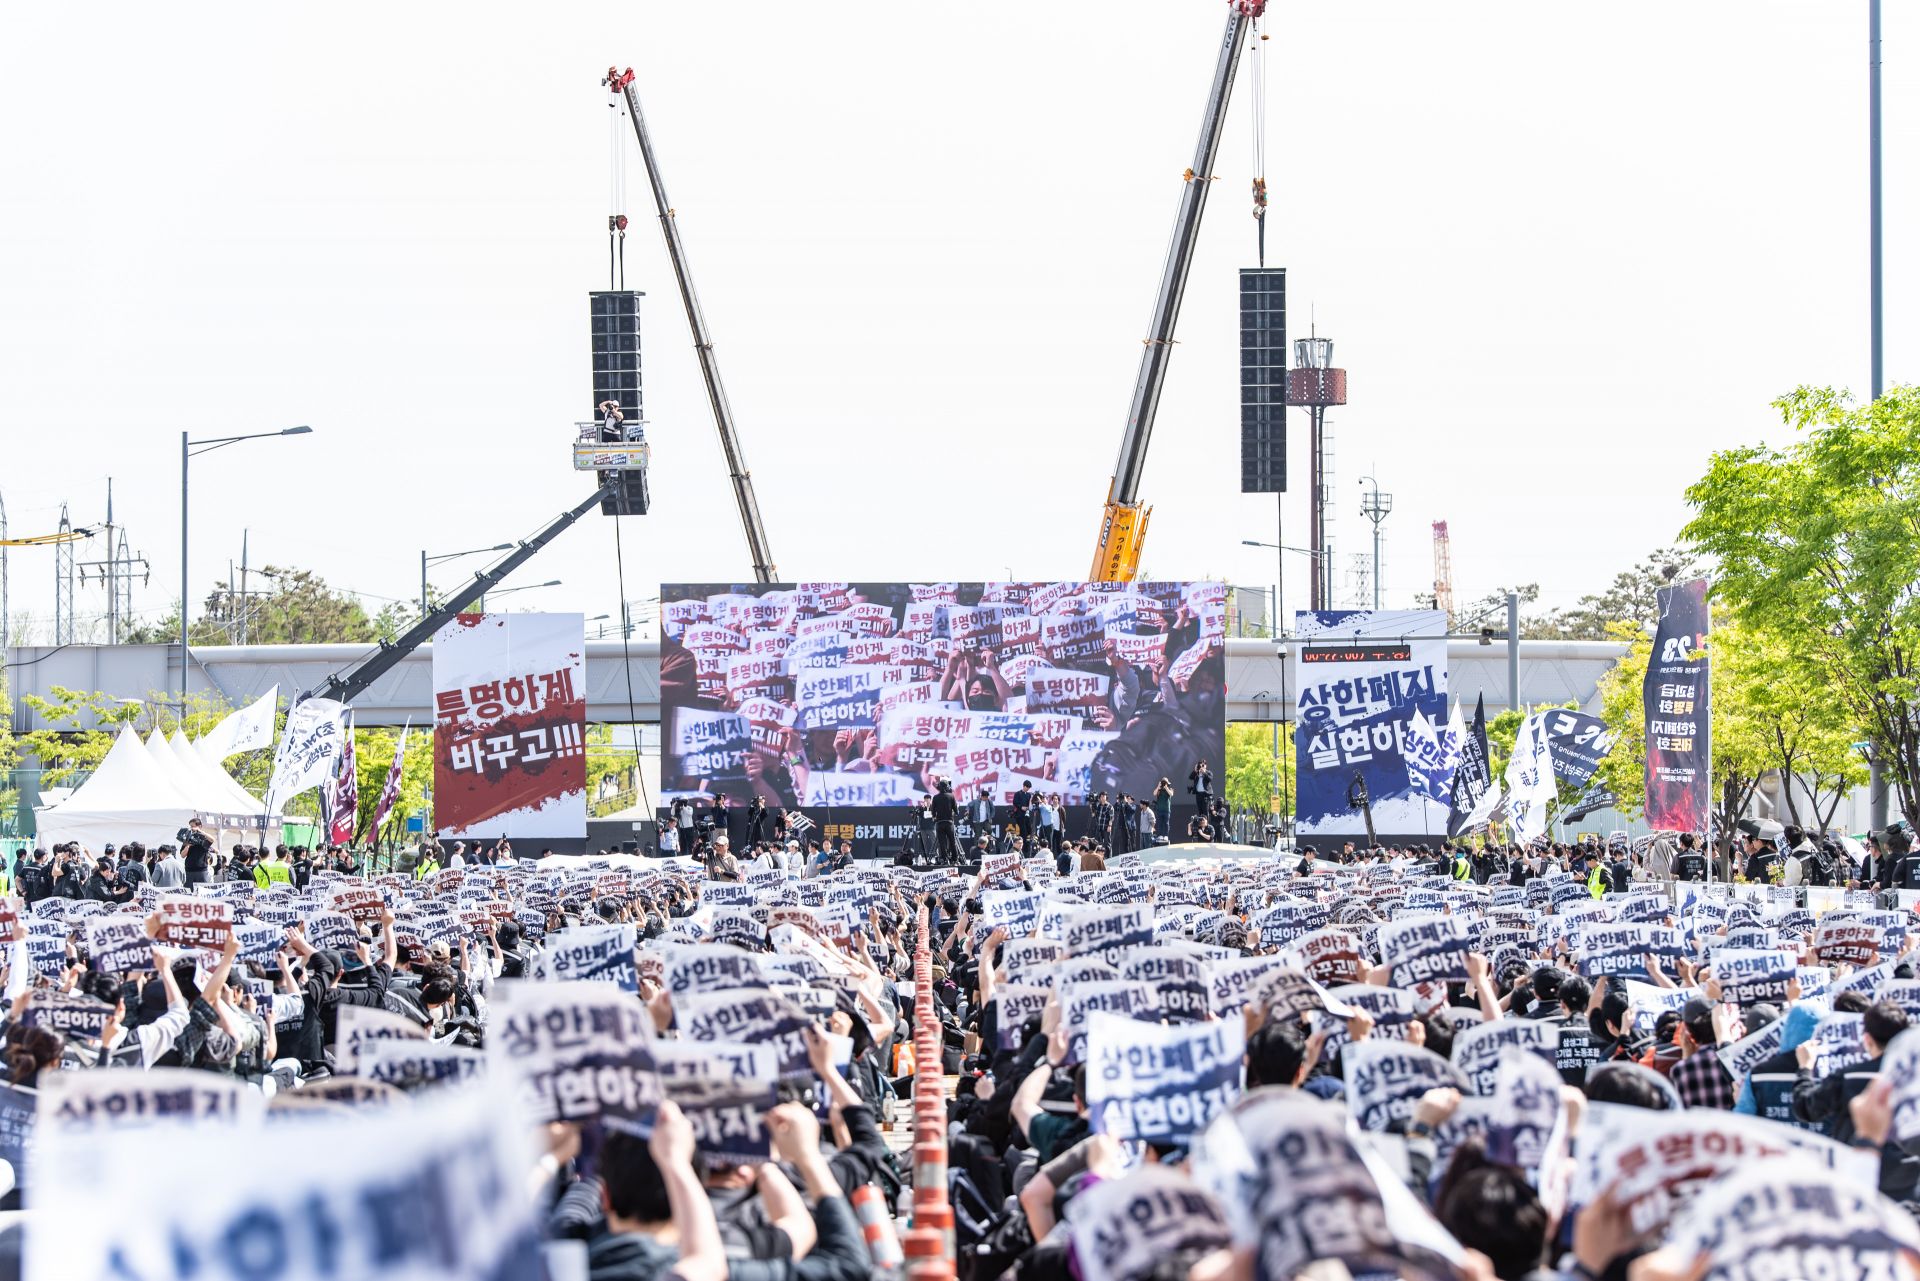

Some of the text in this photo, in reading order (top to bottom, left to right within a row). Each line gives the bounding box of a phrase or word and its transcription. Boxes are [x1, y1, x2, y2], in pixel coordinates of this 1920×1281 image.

[1225, 17, 1236, 48] KATO
[1101, 517, 1111, 548] KATO
[1004, 619, 1031, 638] 하게
[1046, 618, 1098, 640] 투명하게
[1205, 616, 1225, 629] 투명
[1053, 640, 1105, 660] 바꾸고!!!
[1119, 636, 1159, 649] 명하게
[730, 658, 782, 680] 투명하게
[802, 672, 871, 699] 상한폐지
[1032, 677, 1099, 696] 투명하게
[1298, 665, 1436, 722] 상한폐지
[436, 667, 575, 726] 투명하게
[883, 684, 932, 711] 명하게
[804, 700, 875, 728] 실현하자
[683, 717, 744, 744] 상한폐지
[900, 715, 971, 737] 투명하게
[451, 722, 583, 773] 바꾸고!!!
[955, 748, 1032, 775] 투명하게
[824, 824, 884, 839] 투명하게
[984, 855, 1017, 870] 투명하게
[466, 878, 492, 887] 상한폐지
[746, 871, 782, 884] 상한폐지
[857, 871, 884, 881] 상한폐지
[334, 889, 377, 904] 투명하게
[460, 889, 486, 899] 상한폐지
[564, 882, 592, 893] 상한폐지
[703, 886, 748, 902] 상한폐지
[828, 886, 867, 904] 상한폐지
[1158, 891, 1192, 901] 상한폐지
[991, 894, 1045, 918] 상한폐지
[1409, 892, 1444, 903] 상한폐지
[163, 903, 225, 919] 투명하게
[259, 911, 298, 923] 상한폐지
[459, 912, 486, 922] 명하게
[517, 913, 544, 924] 상한폐지
[1564, 909, 1607, 929] 상한폐지
[1698, 904, 1725, 920] 상한폐
[309, 915, 351, 935] 상한폐지
[713, 918, 761, 936] 상한폐지
[1067, 911, 1142, 946] 상한폐지
[1262, 926, 1306, 942] 실현하자
[168, 925, 228, 945] 바꾸고!!!
[1483, 931, 1530, 948] 상한폐지
[1585, 930, 1642, 951] 상한폐지
[1650, 930, 1674, 945] 폐지
[1823, 927, 1875, 943] 투명하게
[553, 935, 623, 971] 상한폐지
[1777, 944, 1799, 953] 하게
[1821, 946, 1872, 961] 바꾸고!!!
[34, 961, 65, 975] 하자
[1588, 953, 1646, 974] 실현하자
[1716, 954, 1785, 979] 상한폐지
[1661, 991, 1690, 1007] 폐지
[1722, 980, 1789, 1002] 실현하자
[1003, 997, 1047, 1018] 상한
[1067, 986, 1151, 1026] 상한폐지
[34, 1008, 108, 1030] 실현하자
[1817, 1021, 1858, 1044] 상한폐
[1458, 1026, 1543, 1069] 상한폐지
[1563, 1038, 1589, 1048] 삼성그룹
[1574, 1048, 1600, 1057] 노동조합
[1101, 1030, 1225, 1081] 상한폐지
[1556, 1058, 1582, 1069] 삼성전자
[695, 1104, 768, 1142] 하자
